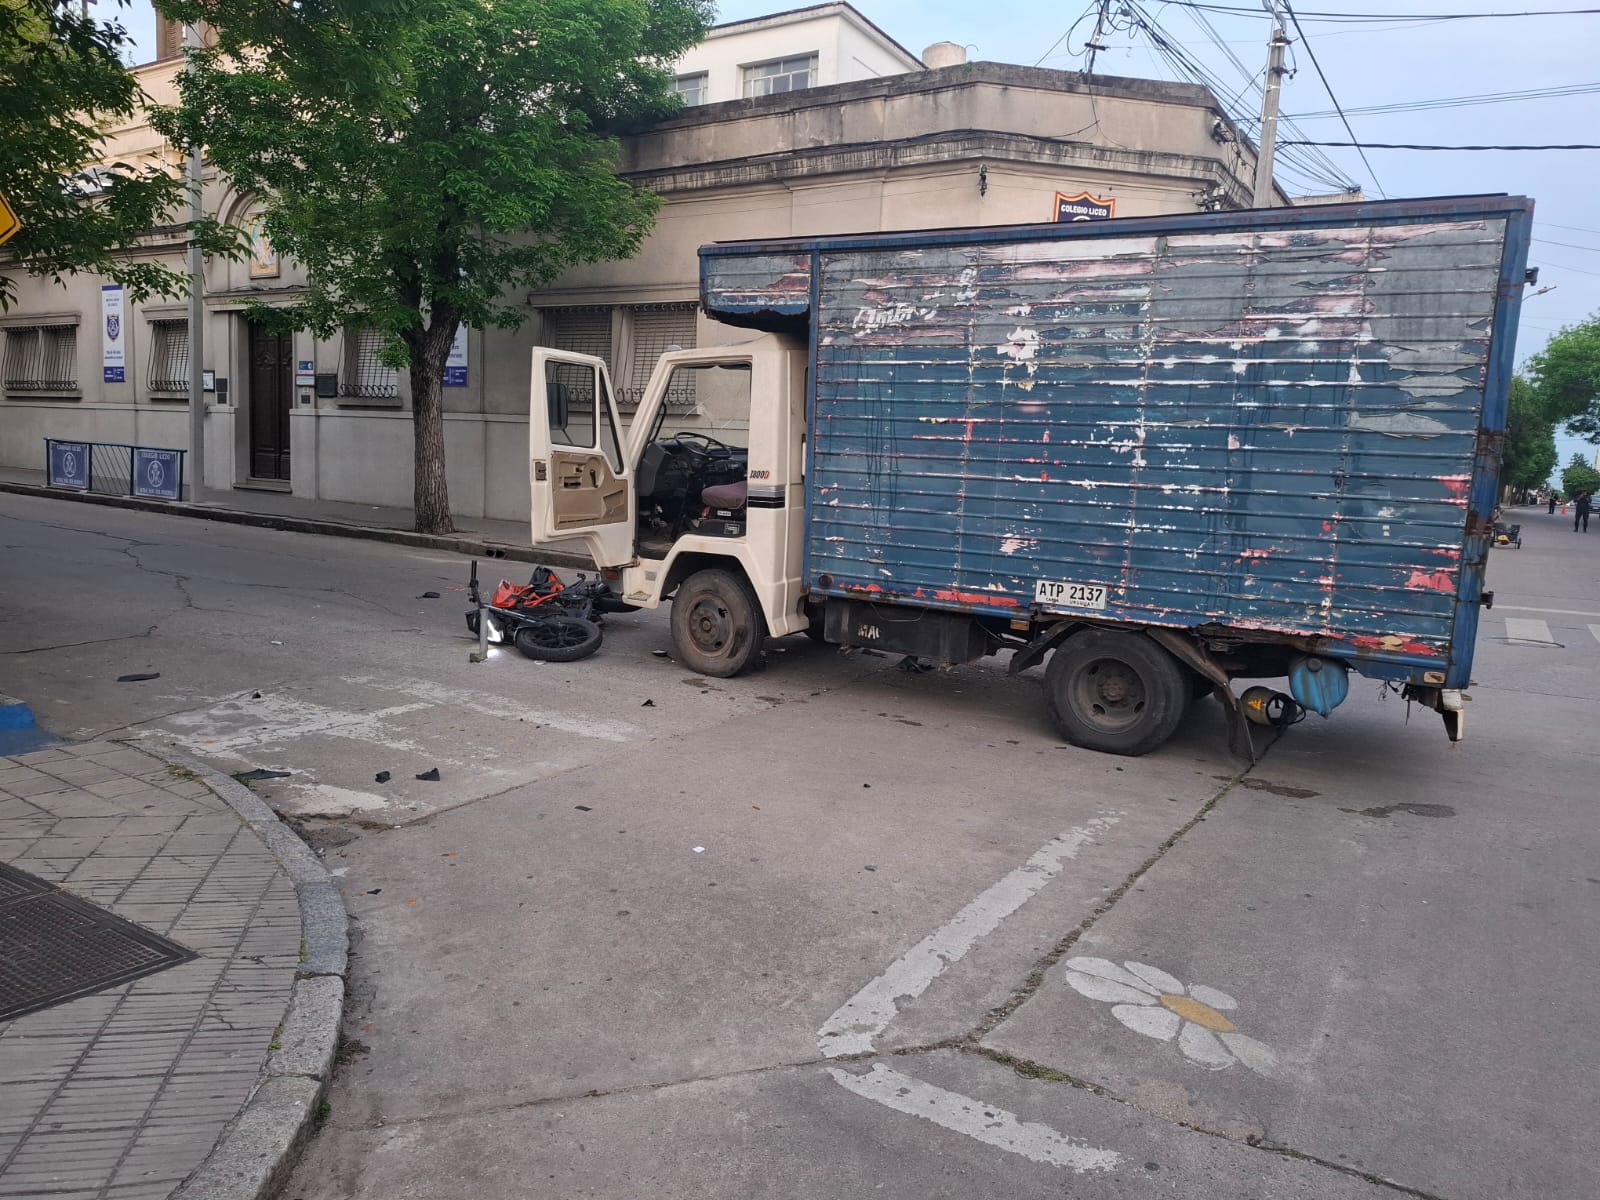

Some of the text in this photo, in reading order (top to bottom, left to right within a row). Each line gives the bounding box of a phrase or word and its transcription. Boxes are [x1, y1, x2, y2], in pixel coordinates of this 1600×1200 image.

[1061, 204, 1107, 216] COLEGIO LICEO
[1040, 583, 1102, 602] ATP 2137
